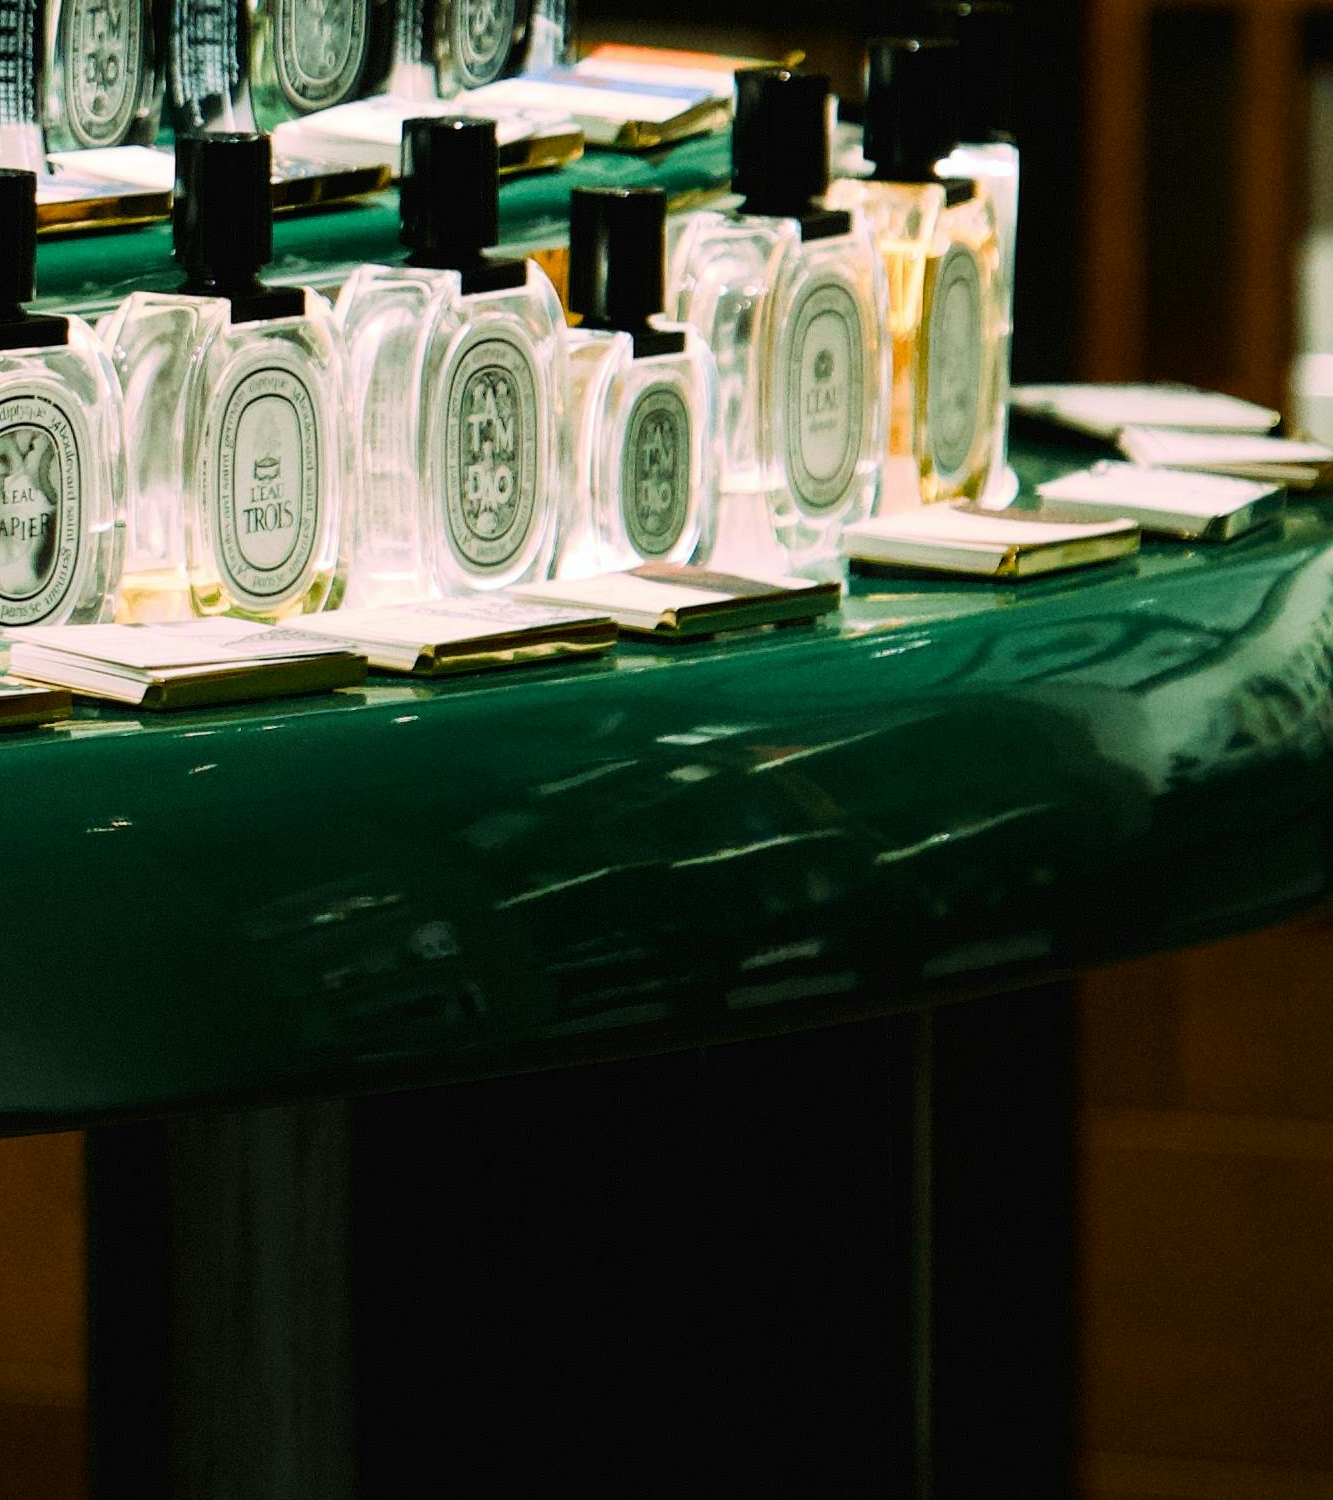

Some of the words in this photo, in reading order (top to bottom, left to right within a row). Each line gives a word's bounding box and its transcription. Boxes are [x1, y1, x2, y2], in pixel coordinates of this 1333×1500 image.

[64, 505, 75, 543] saint
[243, 501, 294, 535] TROIS
[46, 547, 72, 605] germain
